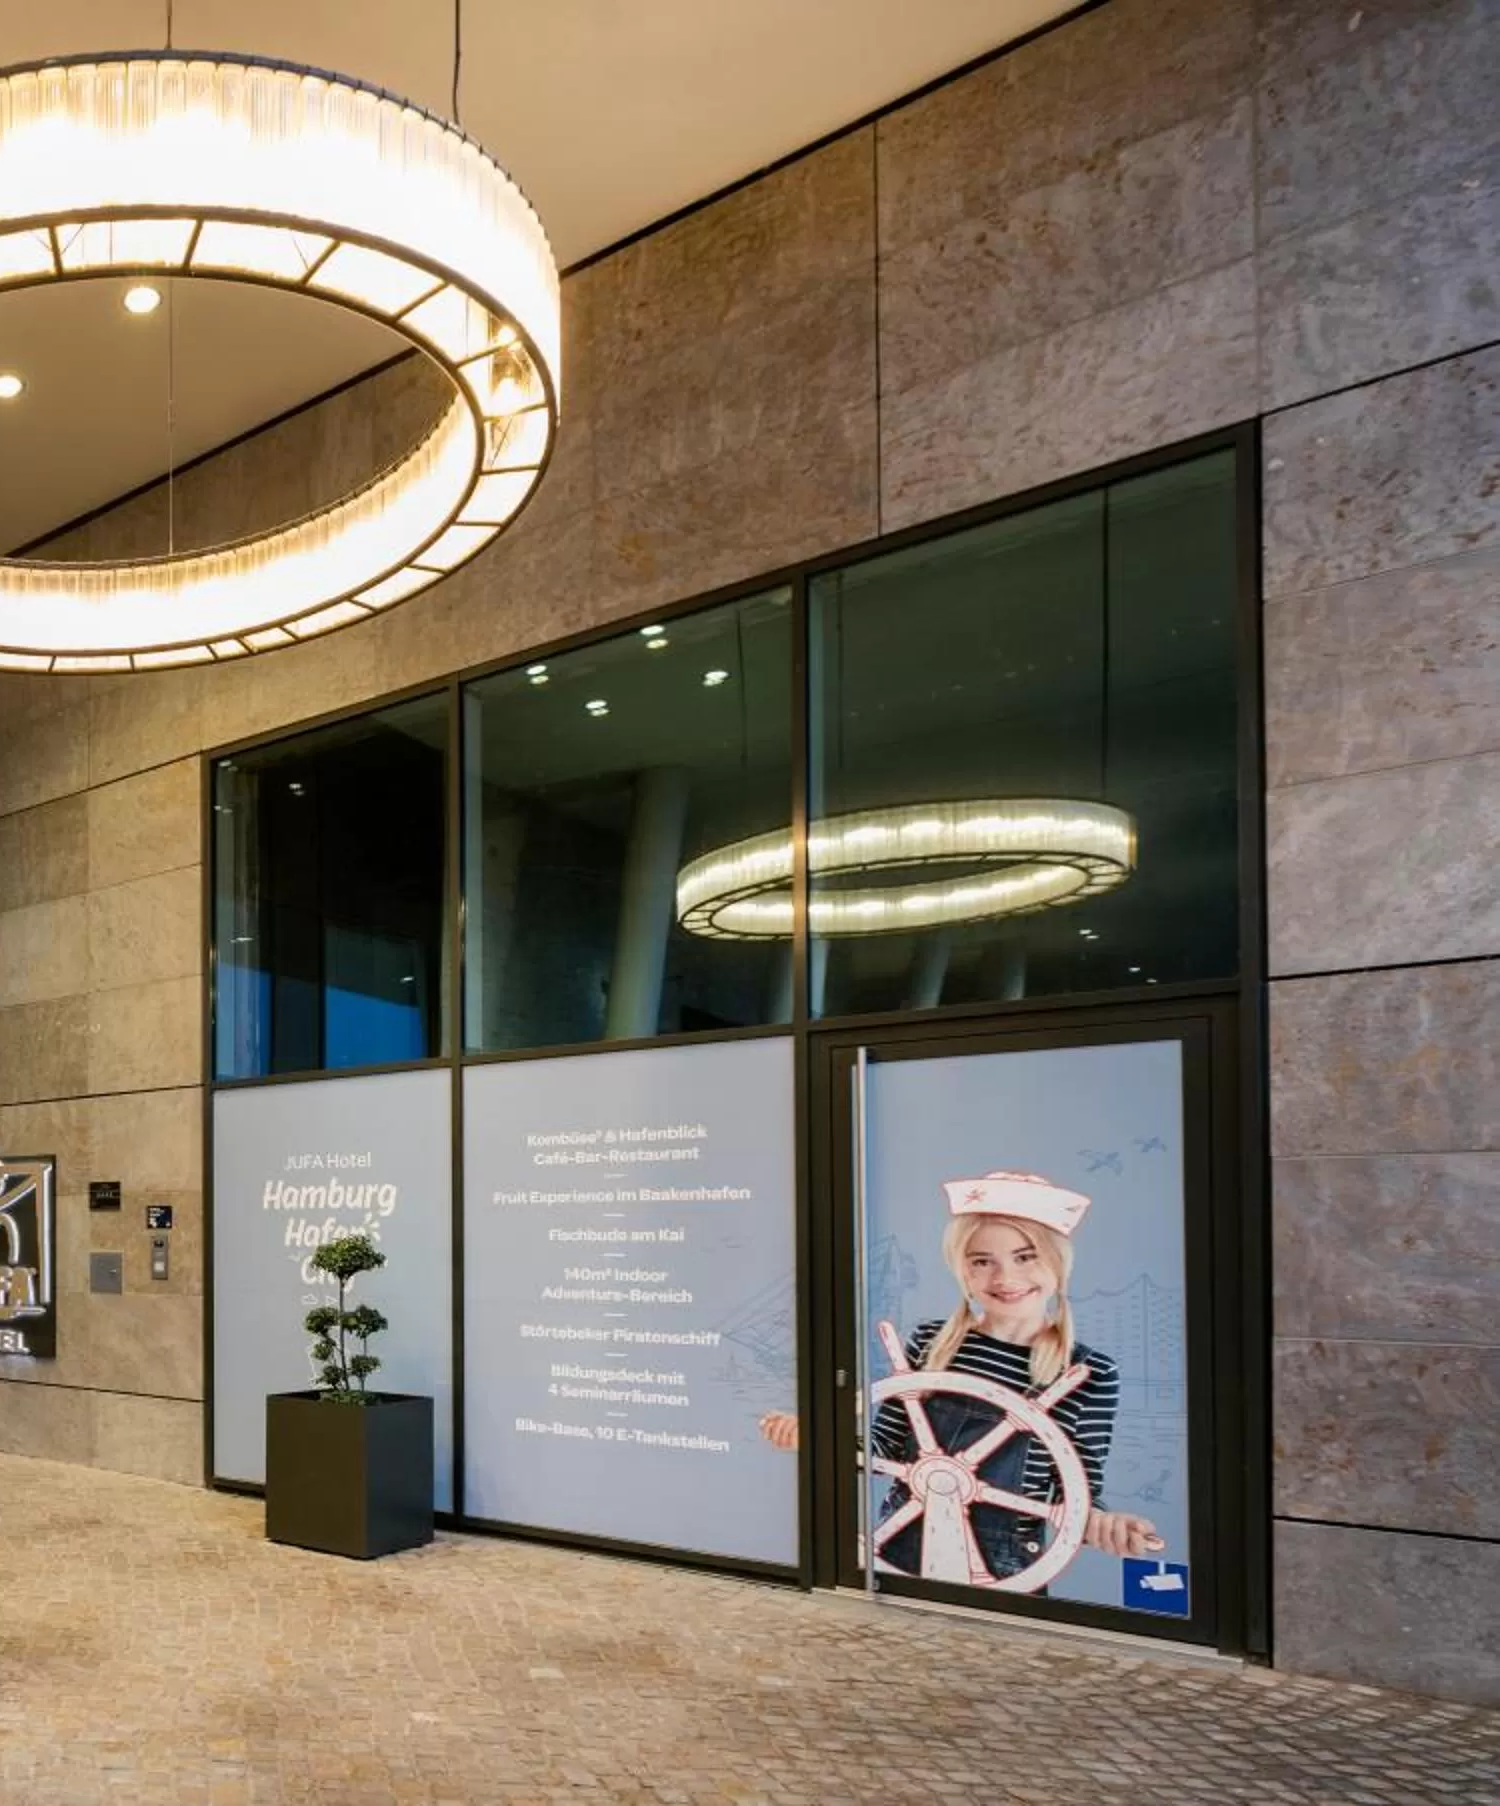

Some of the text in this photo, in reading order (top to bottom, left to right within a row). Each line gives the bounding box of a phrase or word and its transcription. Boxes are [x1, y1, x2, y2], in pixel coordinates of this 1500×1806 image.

[604, 1129, 617, 1143] &
[620, 1124, 708, 1142] Hafenblick
[284, 1152, 372, 1170] JUFA Hotel
[533, 1147, 700, 1165] Café-Bar-Restaurant
[263, 1176, 398, 1217] Hamburg
[493, 1186, 752, 1206] Fruit Experience im Baakenhafen
[549, 1227, 685, 1242] Fischbude am Kai
[615, 1267, 669, 1282] Indoor
[541, 1286, 693, 1304] Adventure-Bereich
[519, 1324, 721, 1346] Störtebeker Piratenschiff
[551, 1364, 687, 1385] Bildungsdeck mit
[548, 1383, 689, 1406] 4 Seminarräumen
[515, 1417, 730, 1451] Bike-Base, 10 E-Tankstellen
